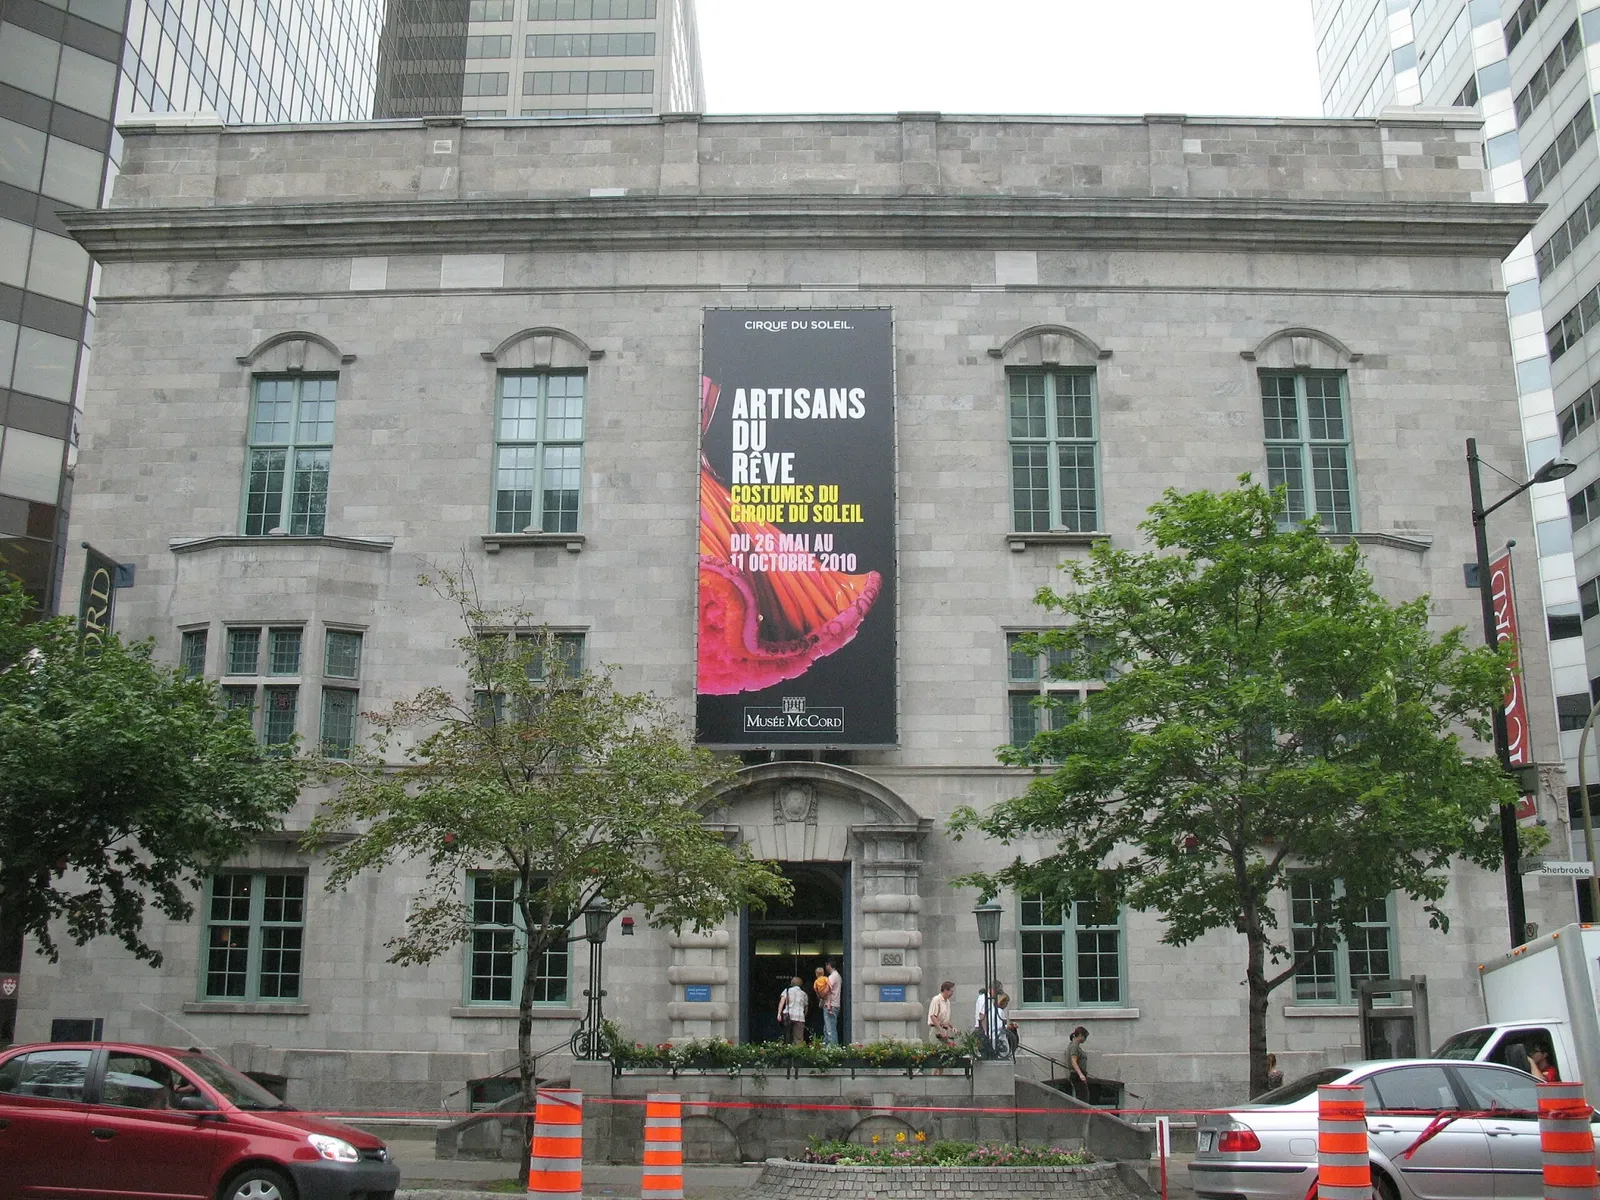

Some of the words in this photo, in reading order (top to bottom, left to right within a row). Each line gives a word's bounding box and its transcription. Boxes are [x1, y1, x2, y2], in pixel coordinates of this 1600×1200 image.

[744, 320, 788, 333] CIRQUE
[791, 320, 808, 330] DU
[731, 387, 866, 420] ARTISANS
[732, 420, 767, 452] DU
[731, 451, 795, 484] RÊVE
[730, 484, 815, 504] COSTUMES
[818, 484, 839, 504] DU
[730, 504, 785, 526] CIRQUE
[788, 504, 809, 523] DU
[812, 504, 864, 523] SOLEIL
[730, 533, 751, 553] DU
[754, 533, 774, 553] 26
[778, 533, 810, 553] MAI
[813, 533, 834, 552] AU
[730, 553, 744, 573] 11
[748, 553, 817, 573] OCTOBRE
[819, 553, 857, 573] 2010
[1541, 865, 1590, 875] Sherbrooke
[883, 953, 902, 964] 690
